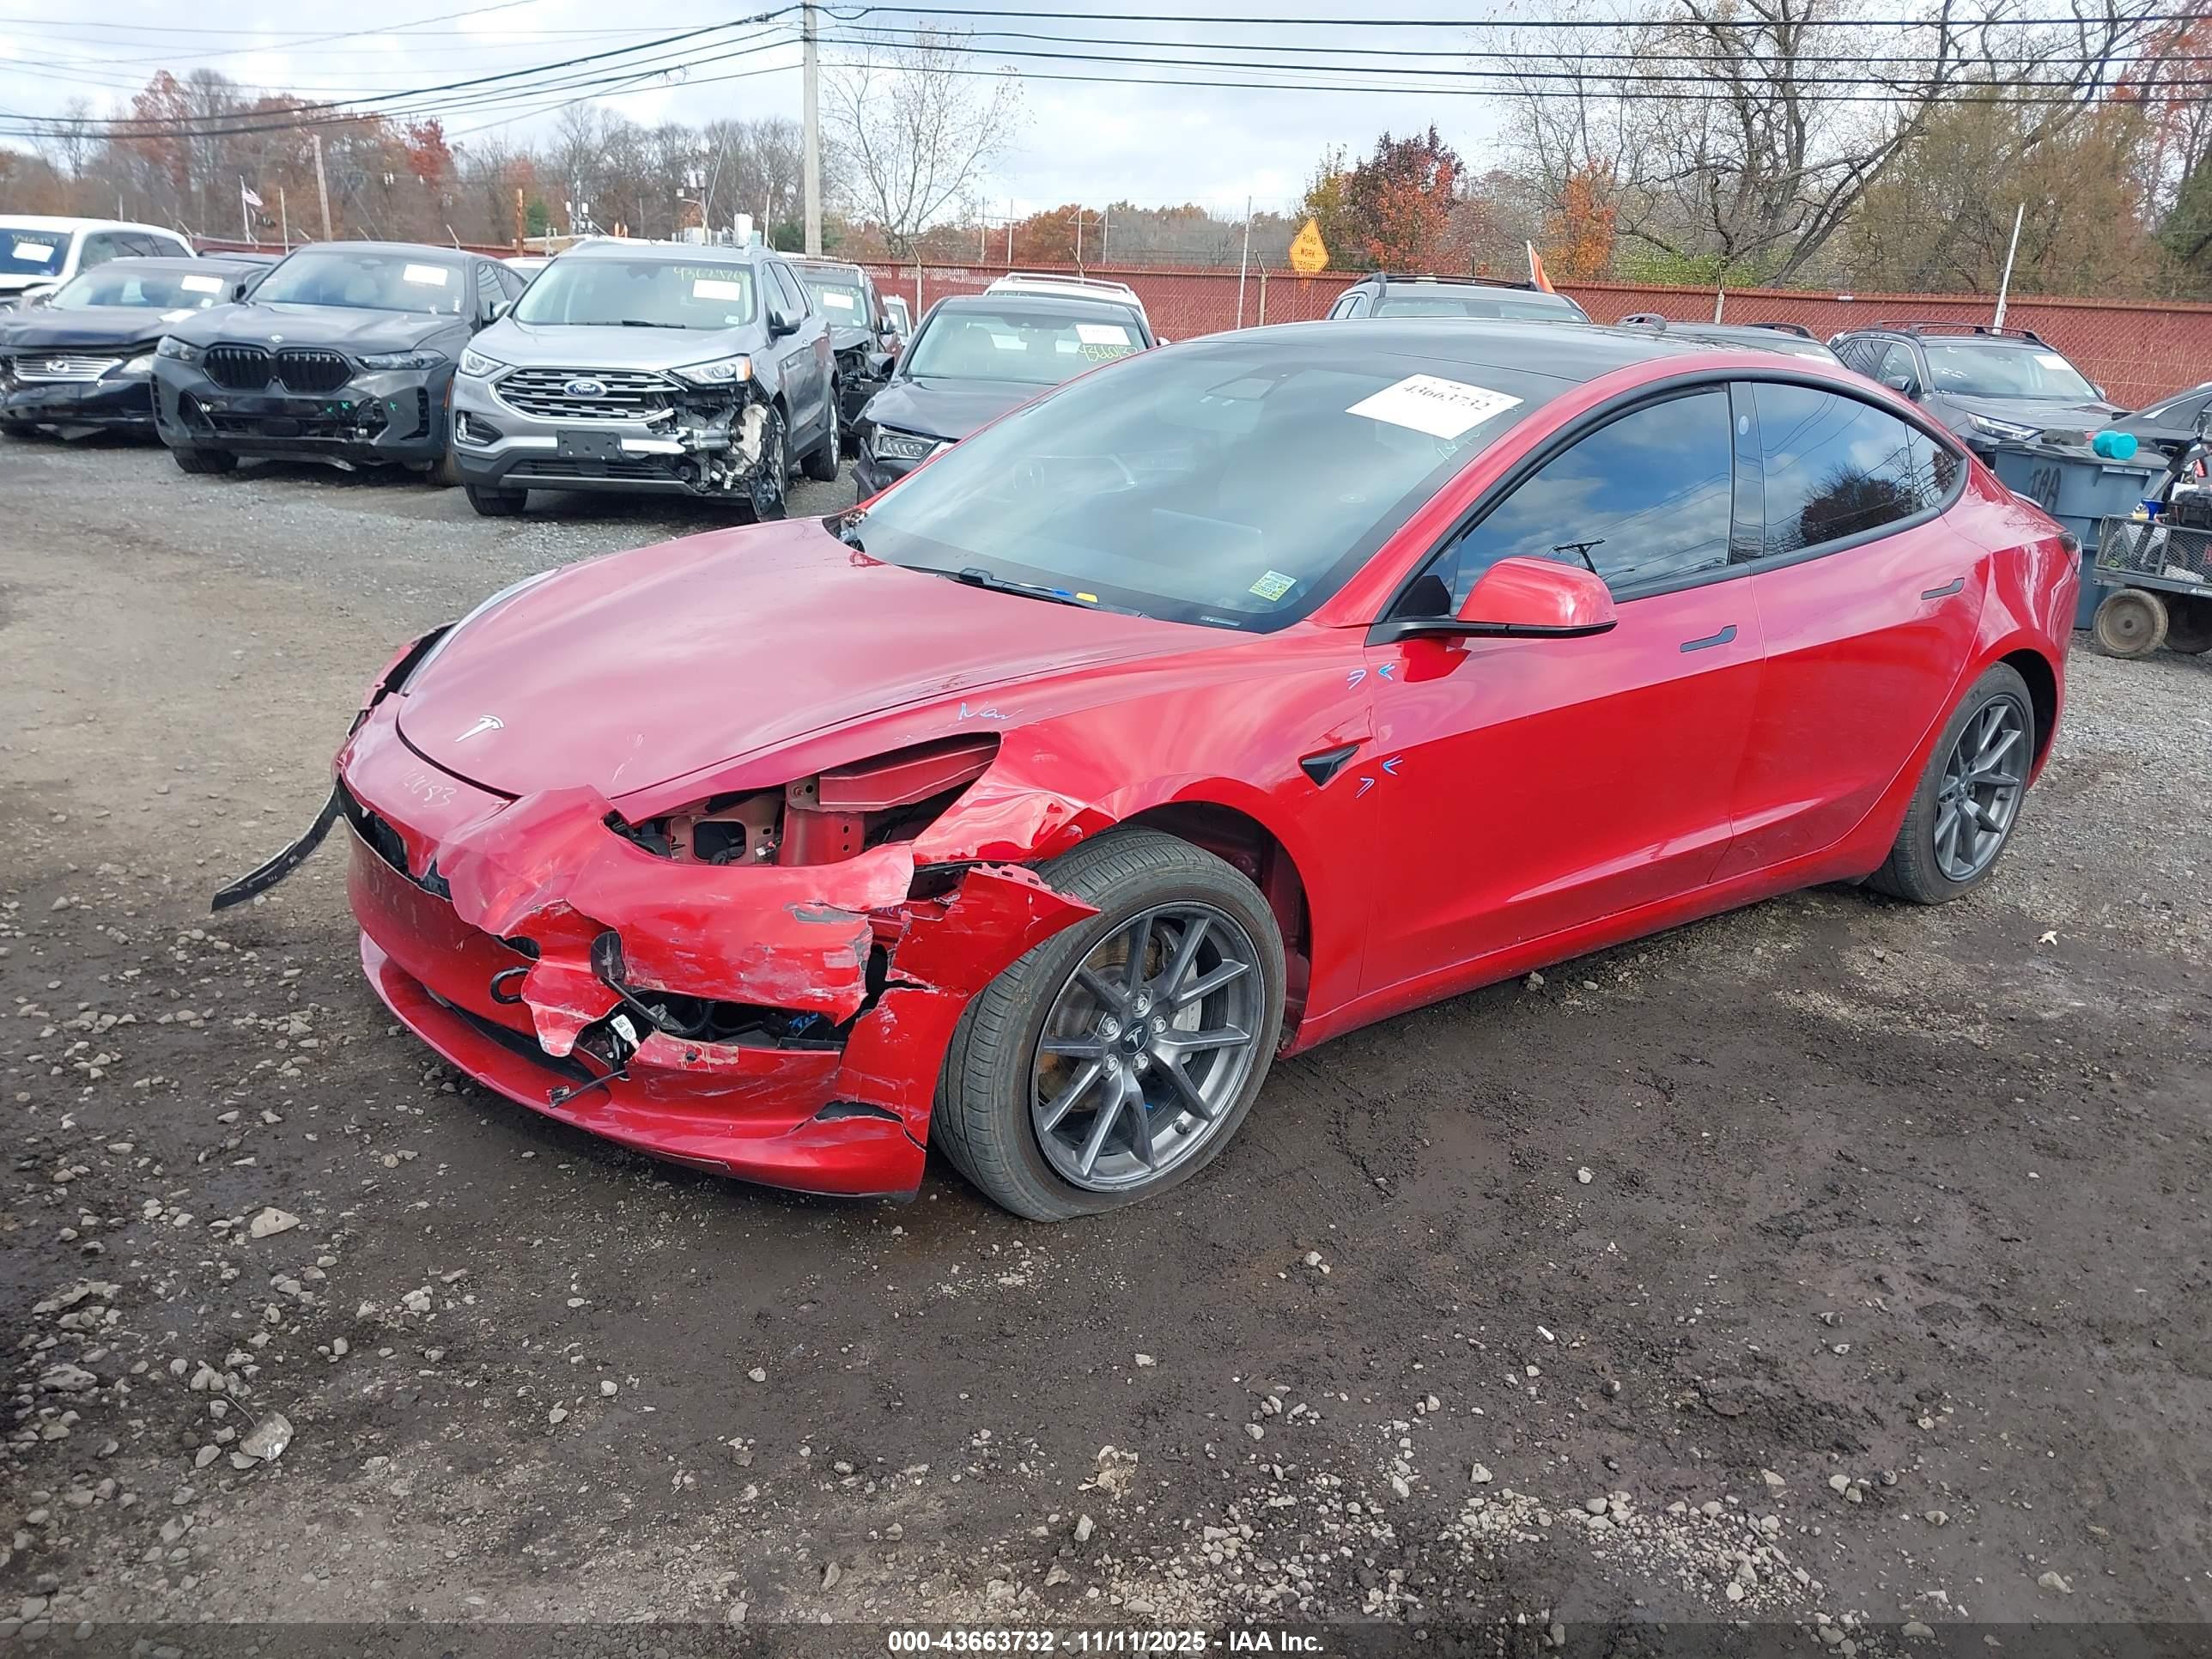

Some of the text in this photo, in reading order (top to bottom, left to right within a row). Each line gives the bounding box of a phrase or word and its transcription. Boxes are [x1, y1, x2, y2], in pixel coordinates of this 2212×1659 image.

[1303, 234, 1317, 246] ROAD
[1300, 247, 1316, 258] WORK
[1402, 384, 1492, 410] 43663732
